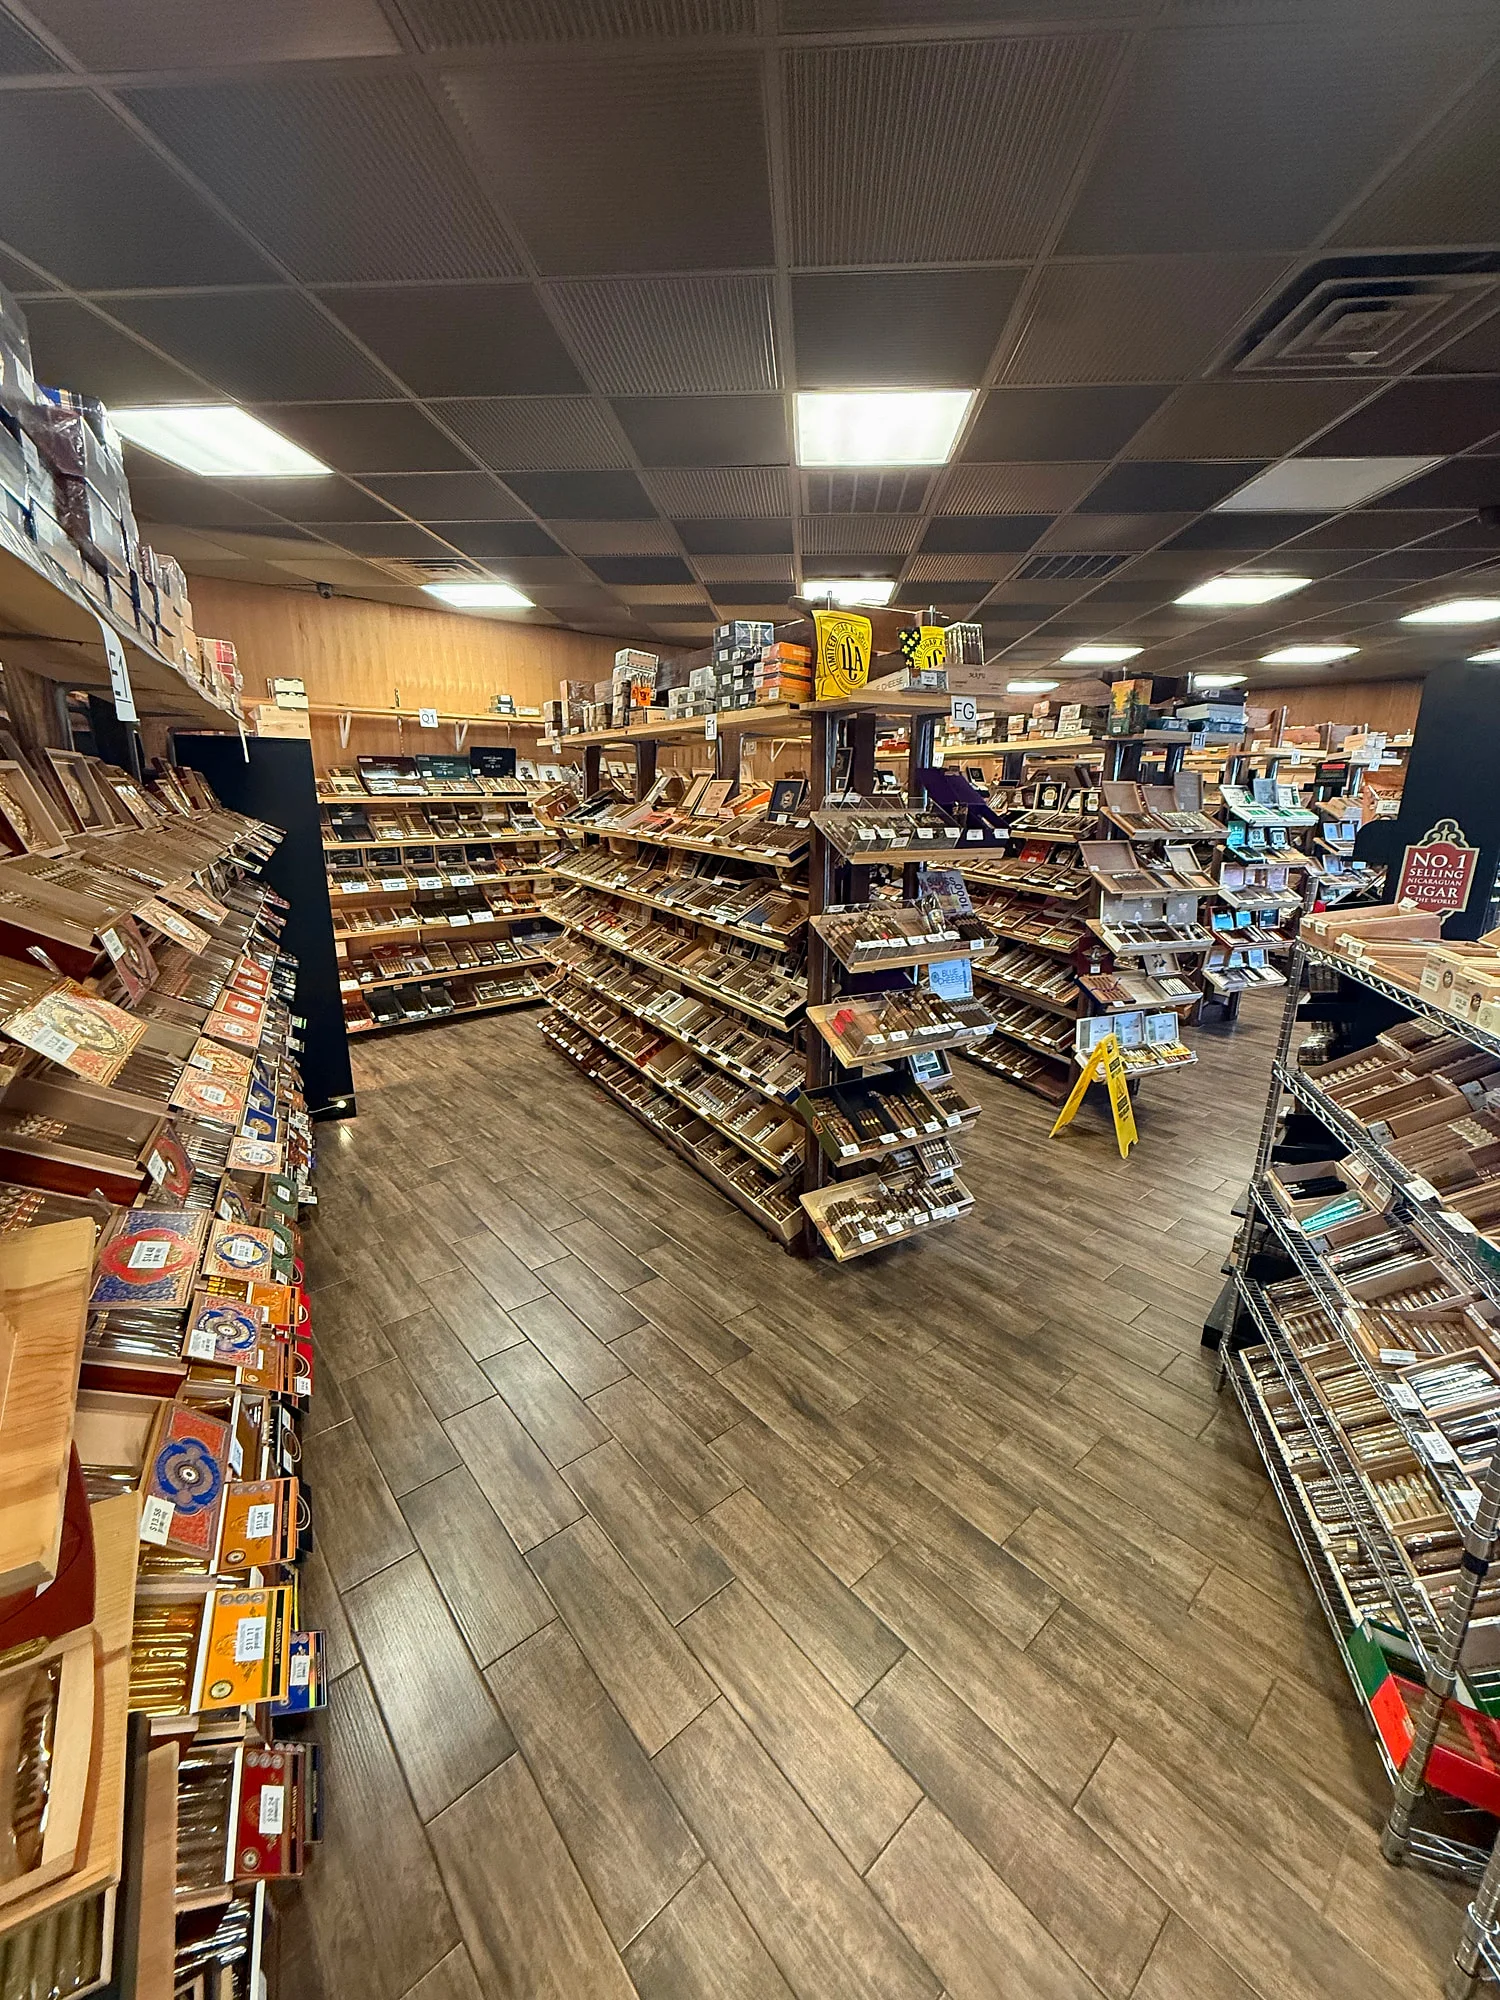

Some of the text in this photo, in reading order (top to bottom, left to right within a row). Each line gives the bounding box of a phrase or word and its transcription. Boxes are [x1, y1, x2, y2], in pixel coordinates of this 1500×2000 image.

[826, 635, 839, 673] LIMITED
[954, 702, 975, 720] FG
[421, 713, 435, 724] Q1
[706, 719, 716, 735] F1
[1409, 867, 1465, 879] SELLING
[1407, 877, 1463, 887] NICARAGUAN
[1405, 884, 1459, 898] CIGAR
[1415, 896, 1429, 904] THE
[941, 967, 958, 977] BLUE
[937, 974, 964, 985] CHEESE
[274, 1617, 283, 1654] ANNIVERSARY
